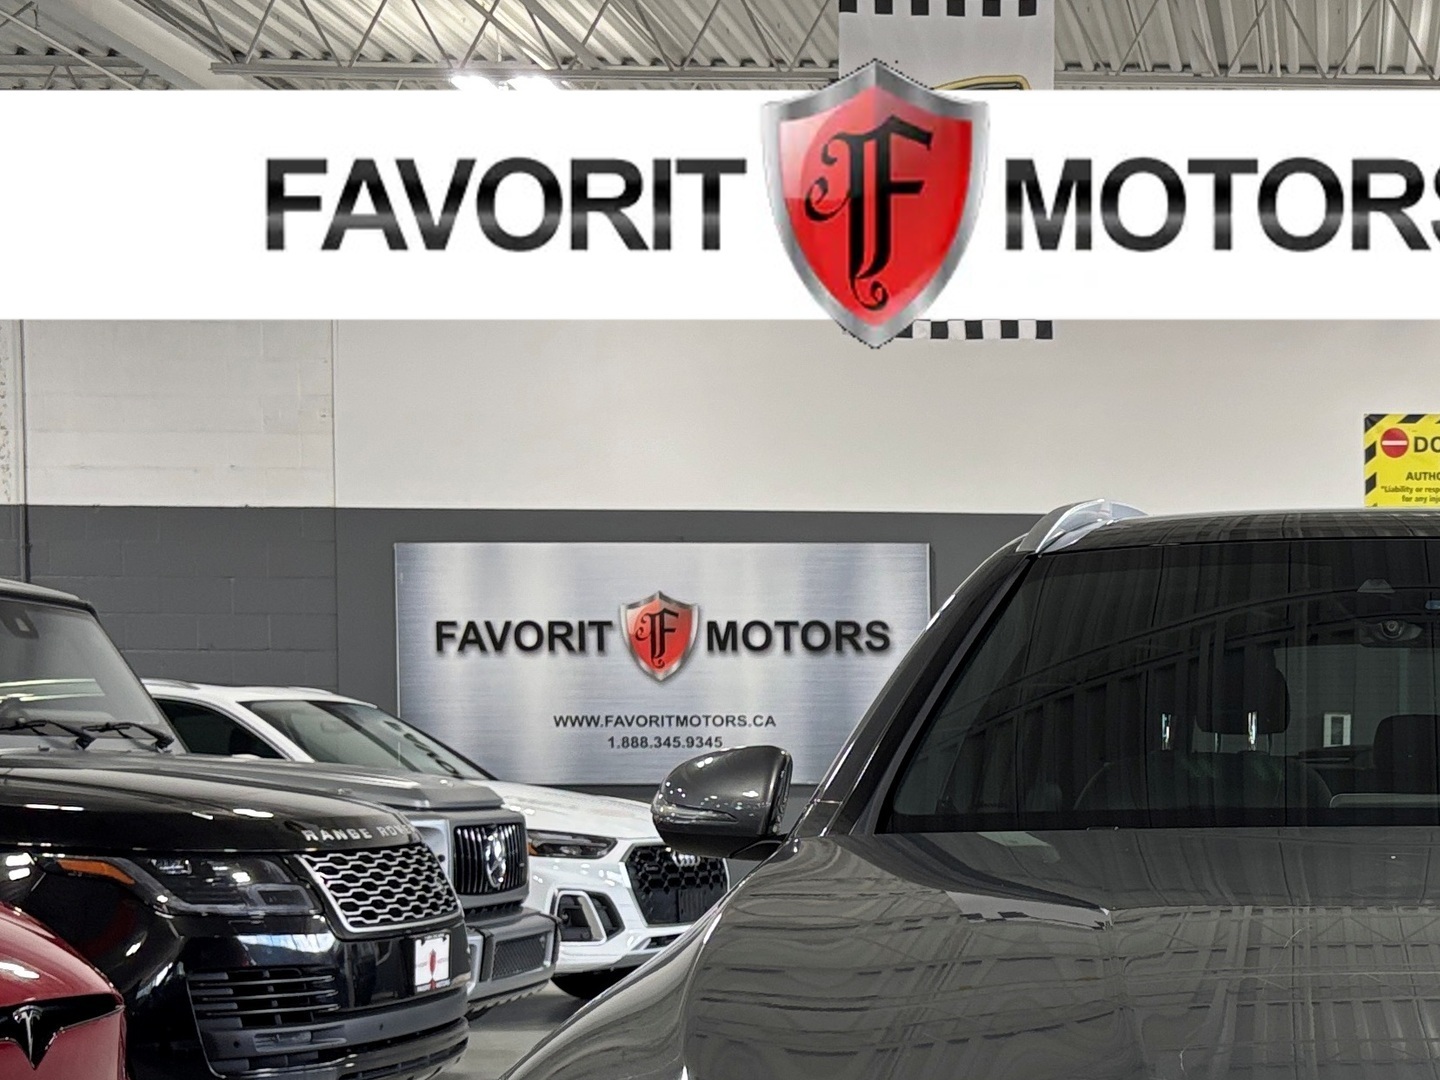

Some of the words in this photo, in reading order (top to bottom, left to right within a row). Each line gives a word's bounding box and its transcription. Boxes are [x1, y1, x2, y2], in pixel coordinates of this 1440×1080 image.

[435, 620, 613, 652] FAVORIT
[706, 619, 891, 652] MOTORS
[553, 714, 777, 728] WWW.FAVORITMOTORS.CA
[607, 735, 723, 749] 1.888.345.9345
[301, 828, 373, 841] RANGE
